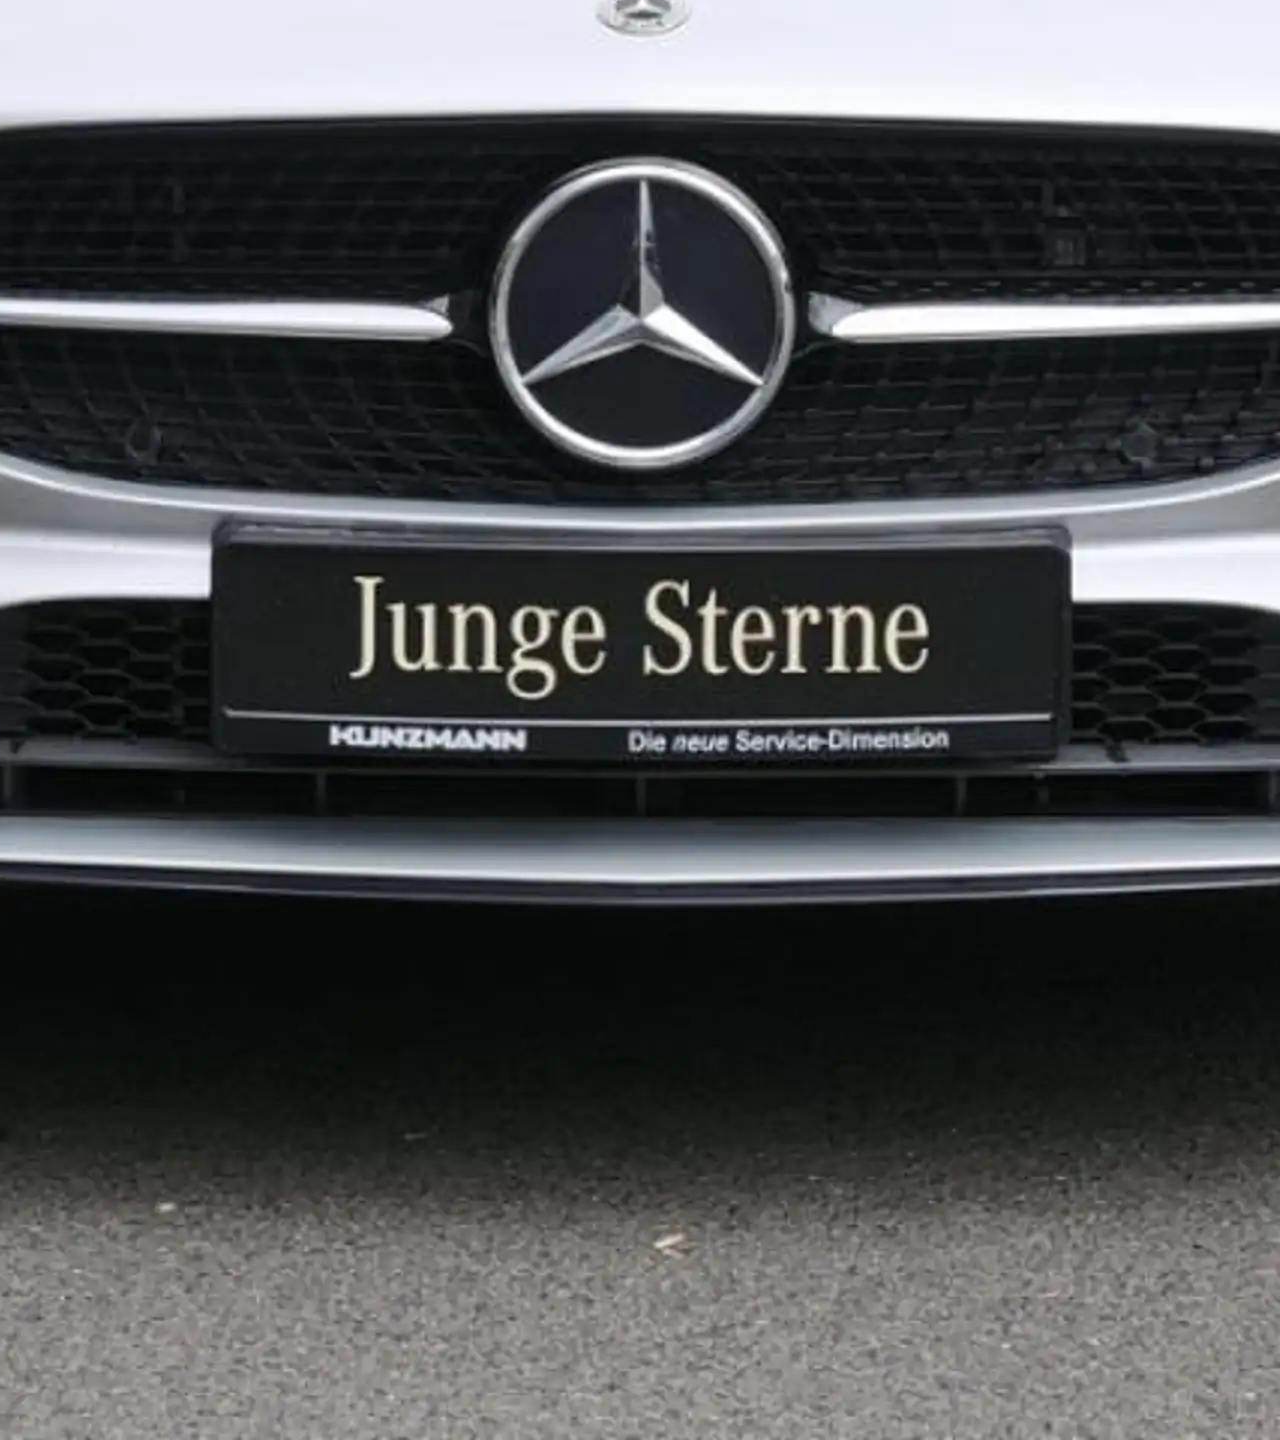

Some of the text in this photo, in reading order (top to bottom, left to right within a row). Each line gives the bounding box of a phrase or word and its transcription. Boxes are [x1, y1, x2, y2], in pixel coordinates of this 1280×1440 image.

[350, 576, 929, 700] Junge Sterne
[329, 724, 527, 751] KUNZMANN
[628, 727, 950, 752] Die neue Service-Dimension
